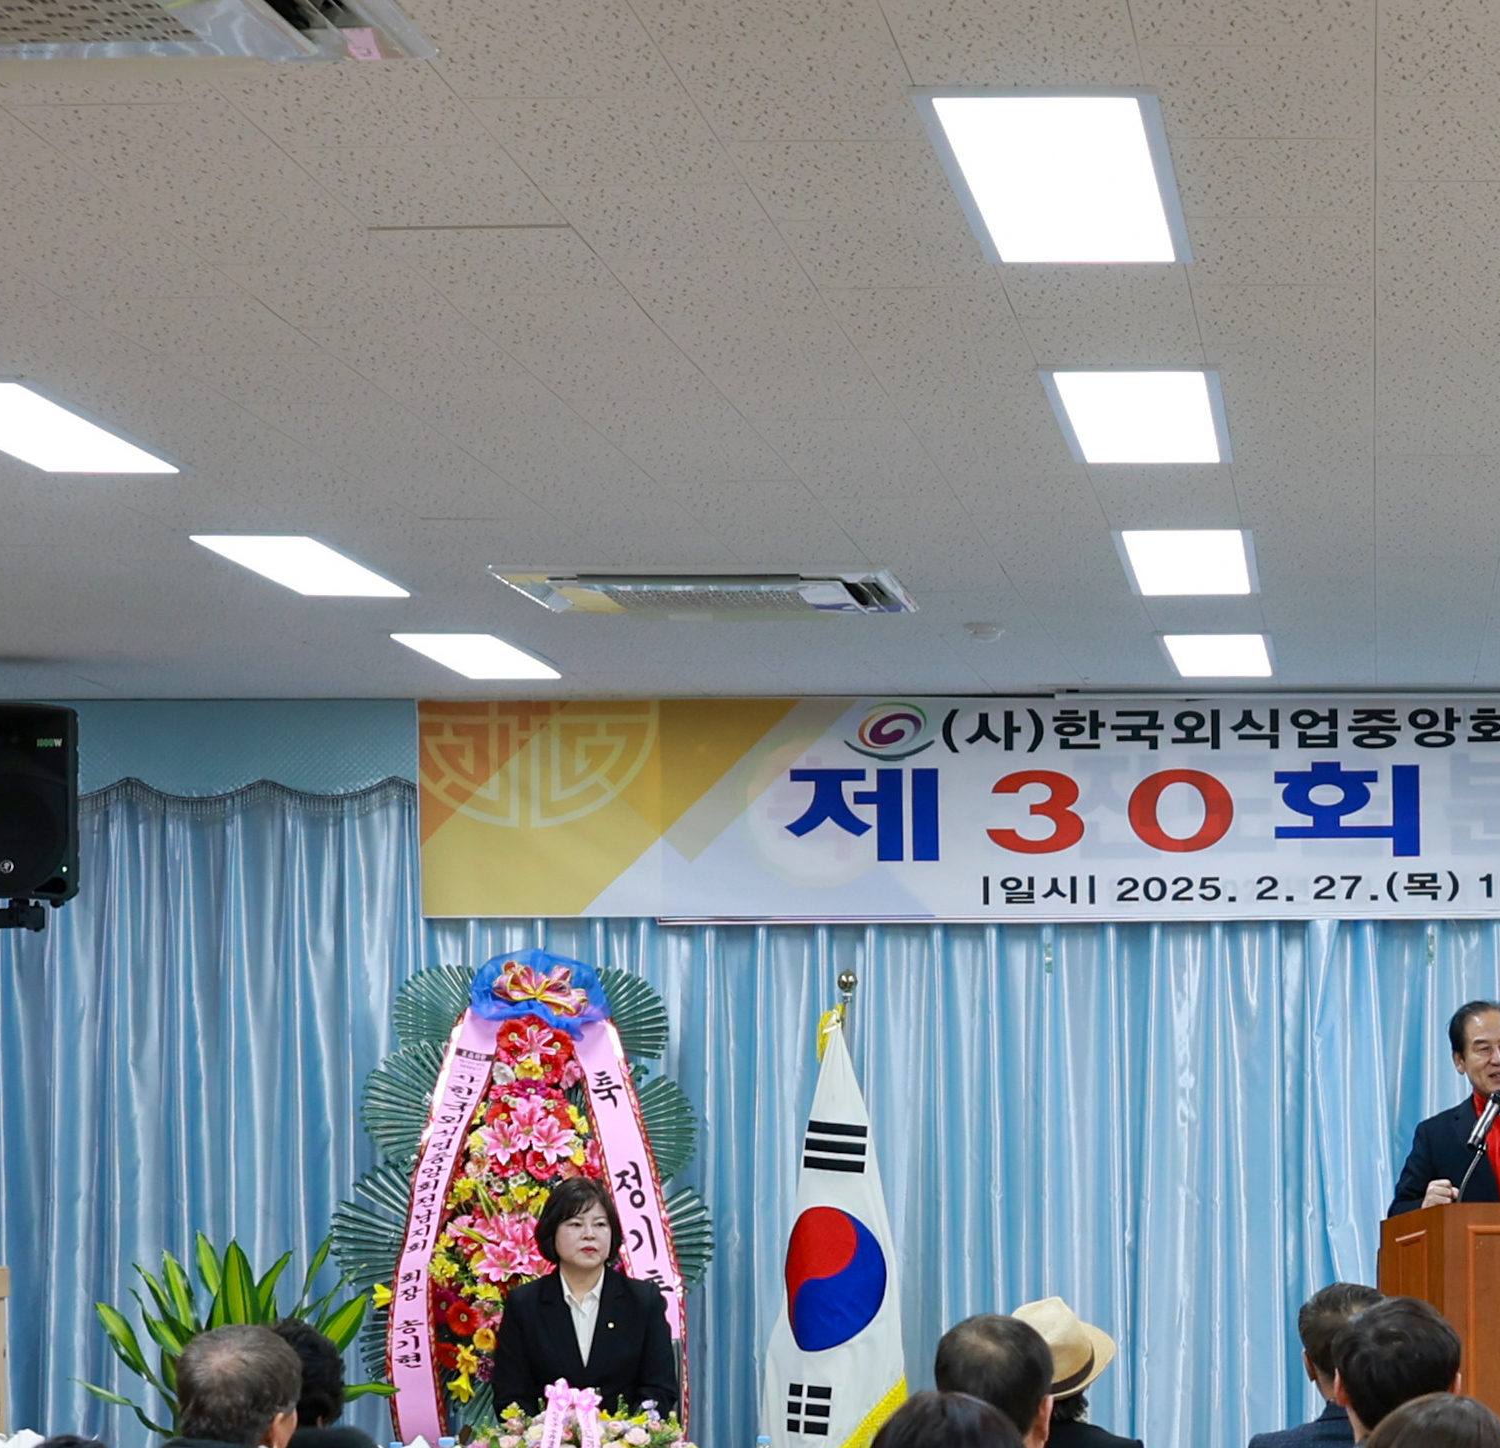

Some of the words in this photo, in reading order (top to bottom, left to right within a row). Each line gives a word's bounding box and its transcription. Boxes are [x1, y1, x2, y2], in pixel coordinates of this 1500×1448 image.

[1116, 876, 1237, 903] 2025.
[1256, 875, 1294, 902] 2.
[1313, 870, 1460, 903] 27.(목)
[591, 1070, 623, 1108] 축
[399, 1269, 423, 1302] 회장
